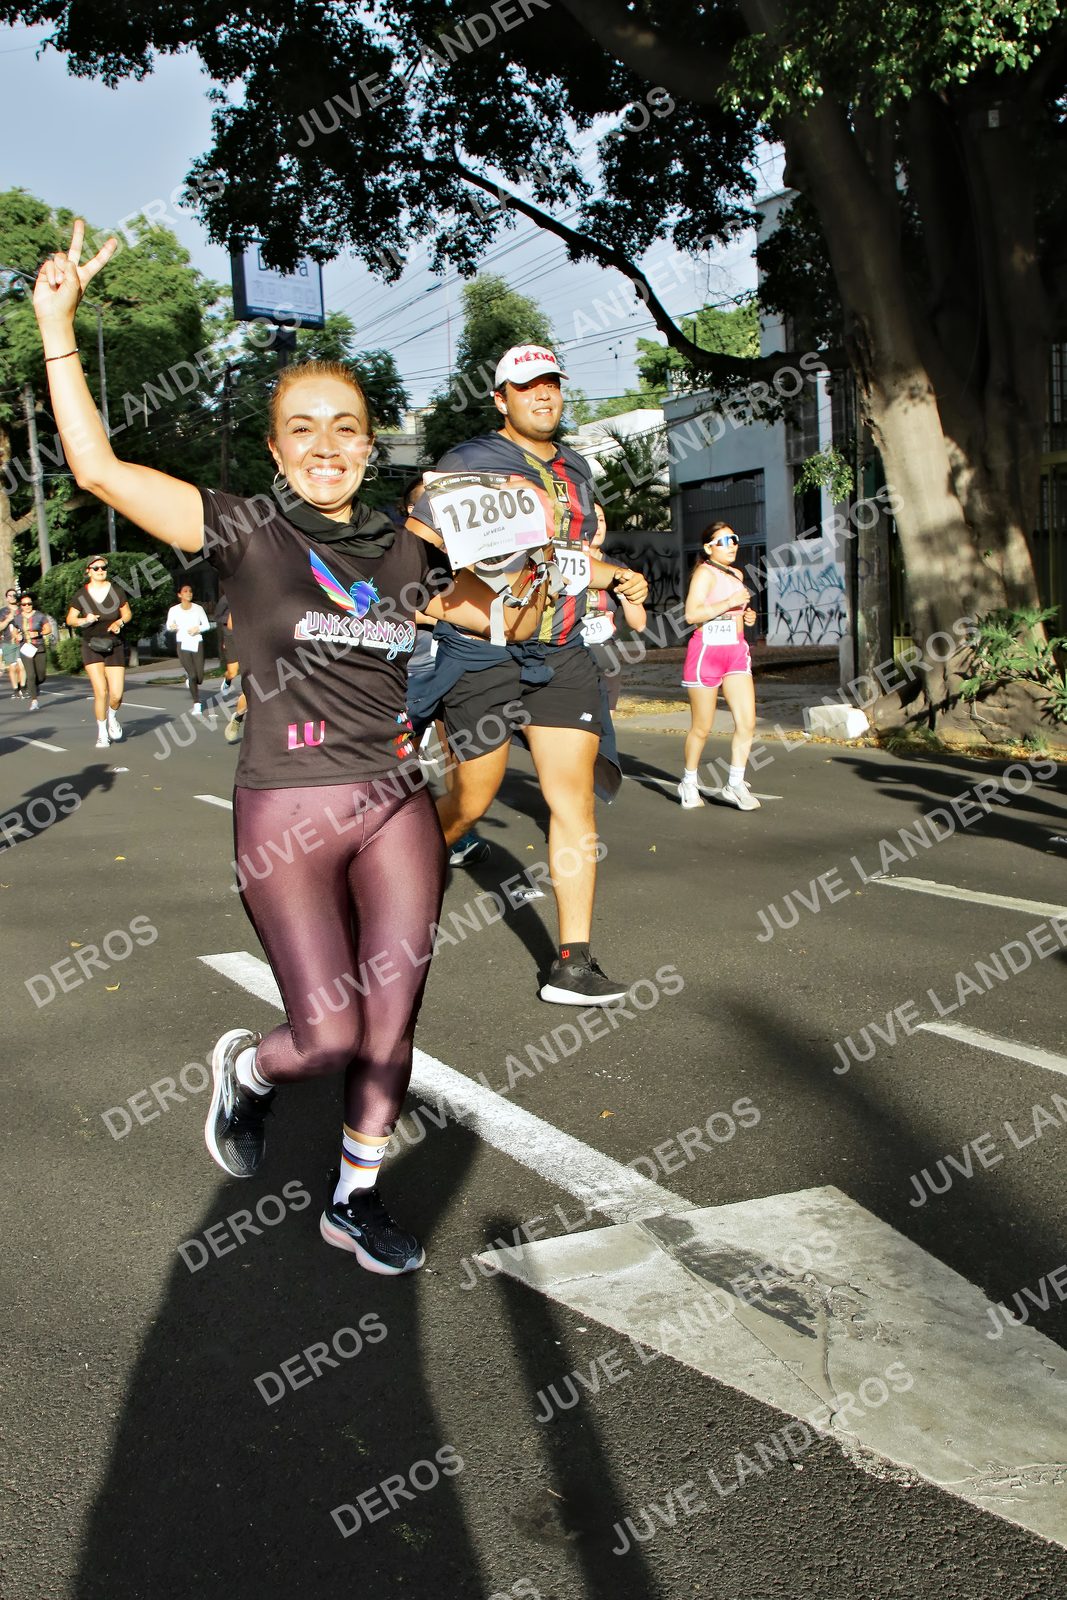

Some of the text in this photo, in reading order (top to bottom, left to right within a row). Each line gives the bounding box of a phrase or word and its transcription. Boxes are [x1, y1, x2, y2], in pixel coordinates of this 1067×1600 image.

[442, 489, 535, 532] 12806
[708, 624, 731, 633] 9744
[288, 720, 325, 750] LU
